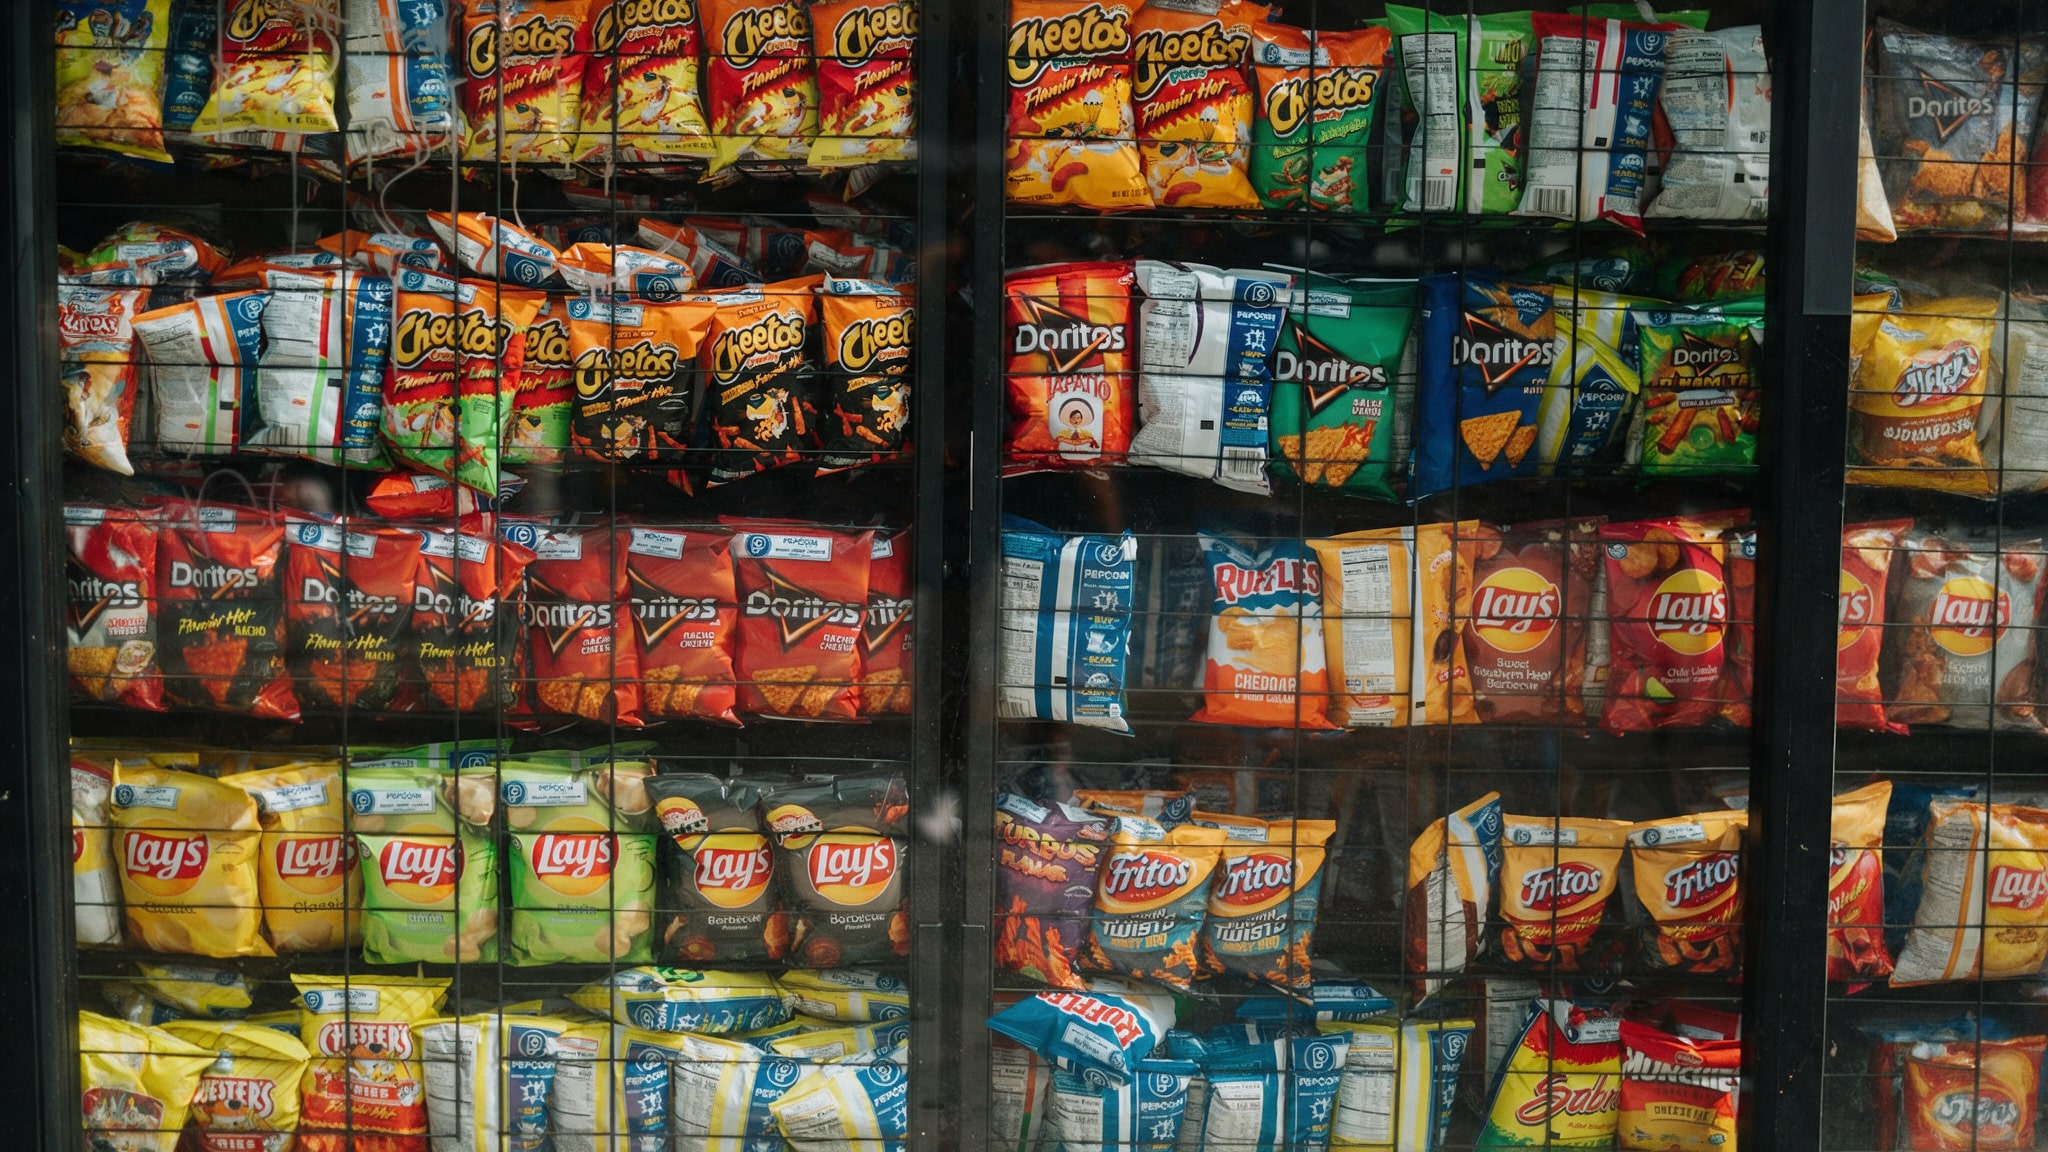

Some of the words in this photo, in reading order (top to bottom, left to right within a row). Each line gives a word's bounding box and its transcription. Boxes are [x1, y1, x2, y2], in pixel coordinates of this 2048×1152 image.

[1008, 10, 1128, 82] Cheetos
[1135, 26, 1246, 96] Cheetos
[1025, 74, 1077, 111] Flamin'
[1080, 65, 1112, 84] Hot
[1142, 88, 1194, 126] Flamin'
[1196, 79, 1230, 100] Hot
[1268, 71, 1374, 132] Cheetos
[1908, 95, 1994, 118] Doritos
[715, 313, 804, 380] Cheetos
[1016, 322, 1126, 353] Doritos
[1453, 335, 1554, 365] Doritos
[1673, 348, 1740, 365] Doritos
[1277, 350, 1386, 383] Doritos
[170, 561, 258, 588] Doritos
[304, 578, 397, 614] Doitos
[1084, 568, 1130, 580] PEPCOIN
[1214, 559, 1321, 604] RUFFLES
[634, 596, 718, 620] oritos
[746, 590, 861, 625] Doritos
[1476, 586, 1556, 634] Lay's
[1655, 588, 1726, 636] Lay's
[1234, 673, 1296, 693] CHEDDAR
[126, 831, 206, 880] Lay's
[385, 838, 460, 888] Lay's
[537, 834, 613, 880] Lay's
[698, 845, 771, 891] Lay's
[815, 840, 890, 888] Lay's
[1106, 852, 1190, 895] Fritos
[1217, 854, 1293, 898] Fritos
[1522, 866, 1602, 907] Fritos
[1664, 855, 1739, 907] Fritos
[707, 914, 761, 926] Barbecue
[319, 1022, 413, 1061] CHESTER'S
